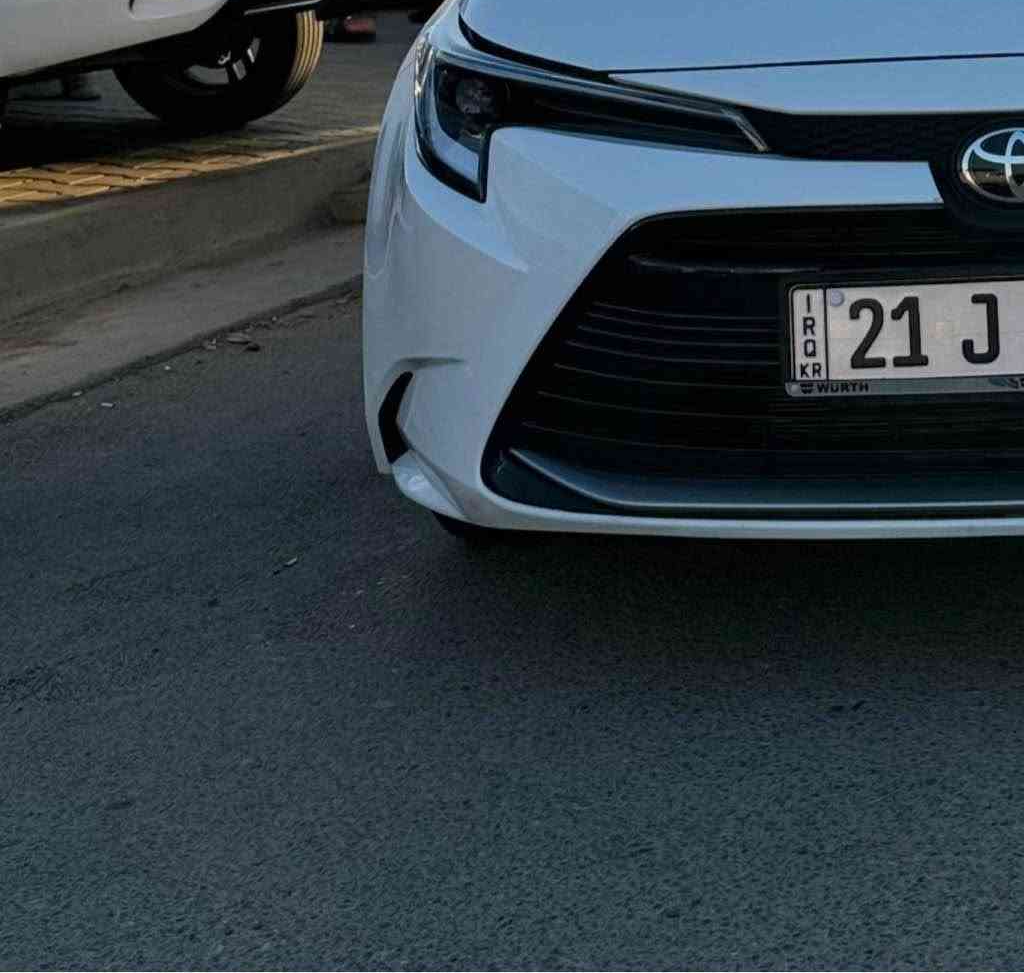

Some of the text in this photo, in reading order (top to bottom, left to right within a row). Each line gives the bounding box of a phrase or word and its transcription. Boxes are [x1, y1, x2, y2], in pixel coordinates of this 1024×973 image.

[849, 296, 929, 369] 21
[961, 293, 1000, 364] J
[800, 362, 822, 378] KR
